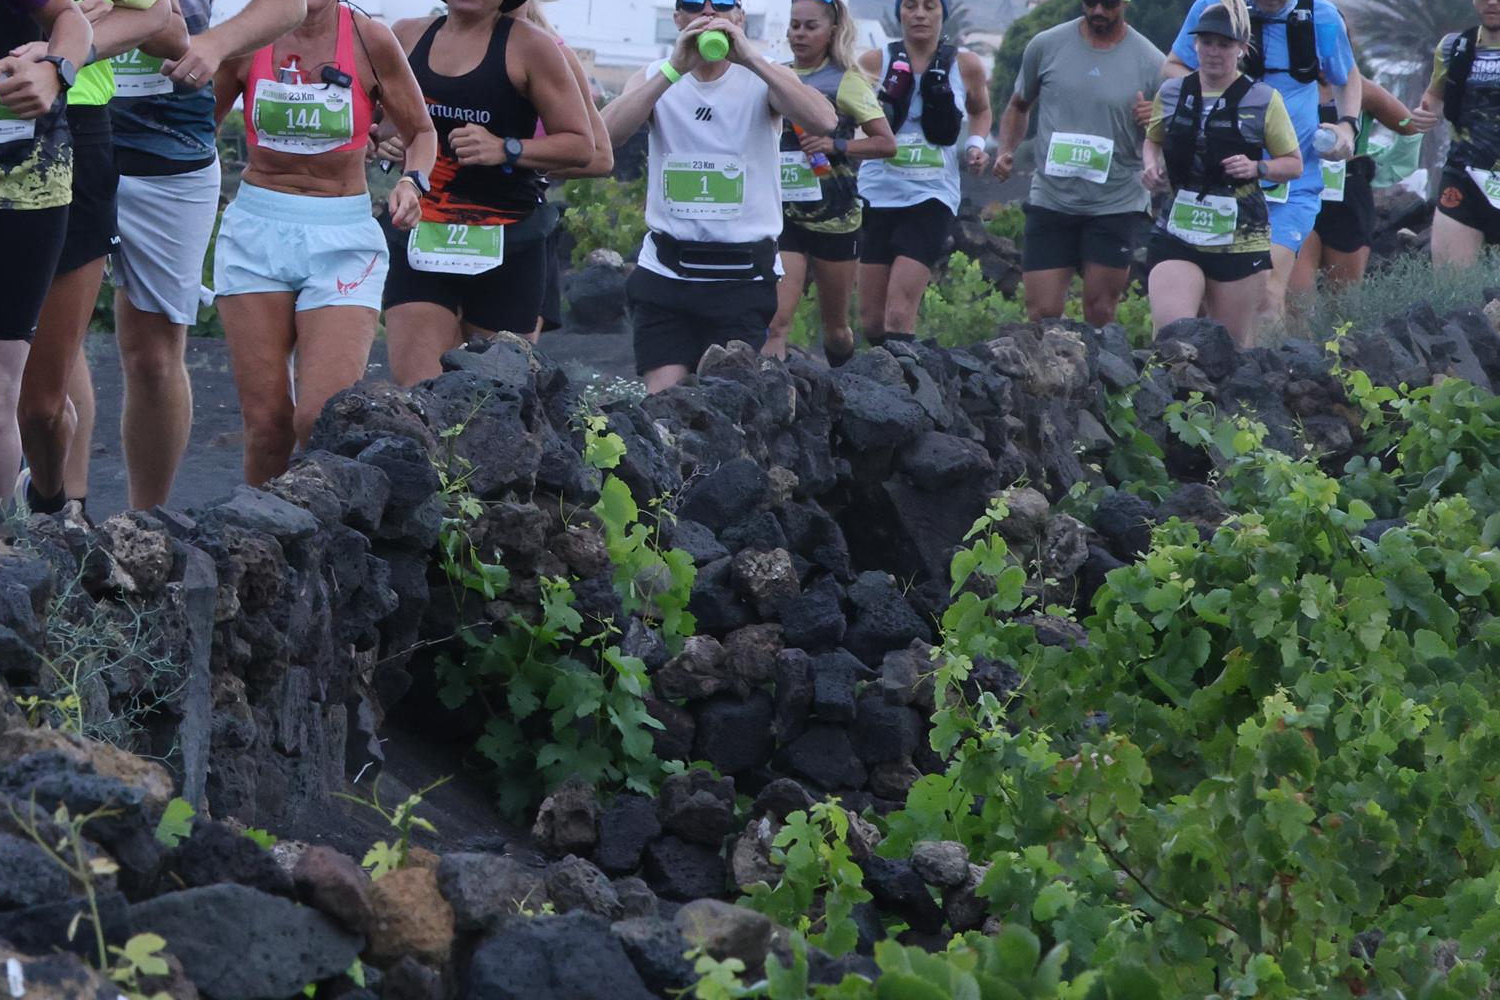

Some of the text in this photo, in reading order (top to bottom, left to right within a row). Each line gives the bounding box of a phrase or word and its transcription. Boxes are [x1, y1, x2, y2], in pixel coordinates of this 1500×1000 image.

[288, 93, 300, 101] 23
[301, 92, 315, 101] Km
[285, 108, 322, 130] 144
[426, 103, 491, 124] NTUARIO
[692, 160, 702, 169] 23
[703, 161, 715, 169] Km
[1070, 147, 1092, 164] 119
[700, 175, 709, 195] 1
[1191, 209, 1215, 228] 231
[447, 224, 469, 245] 22
